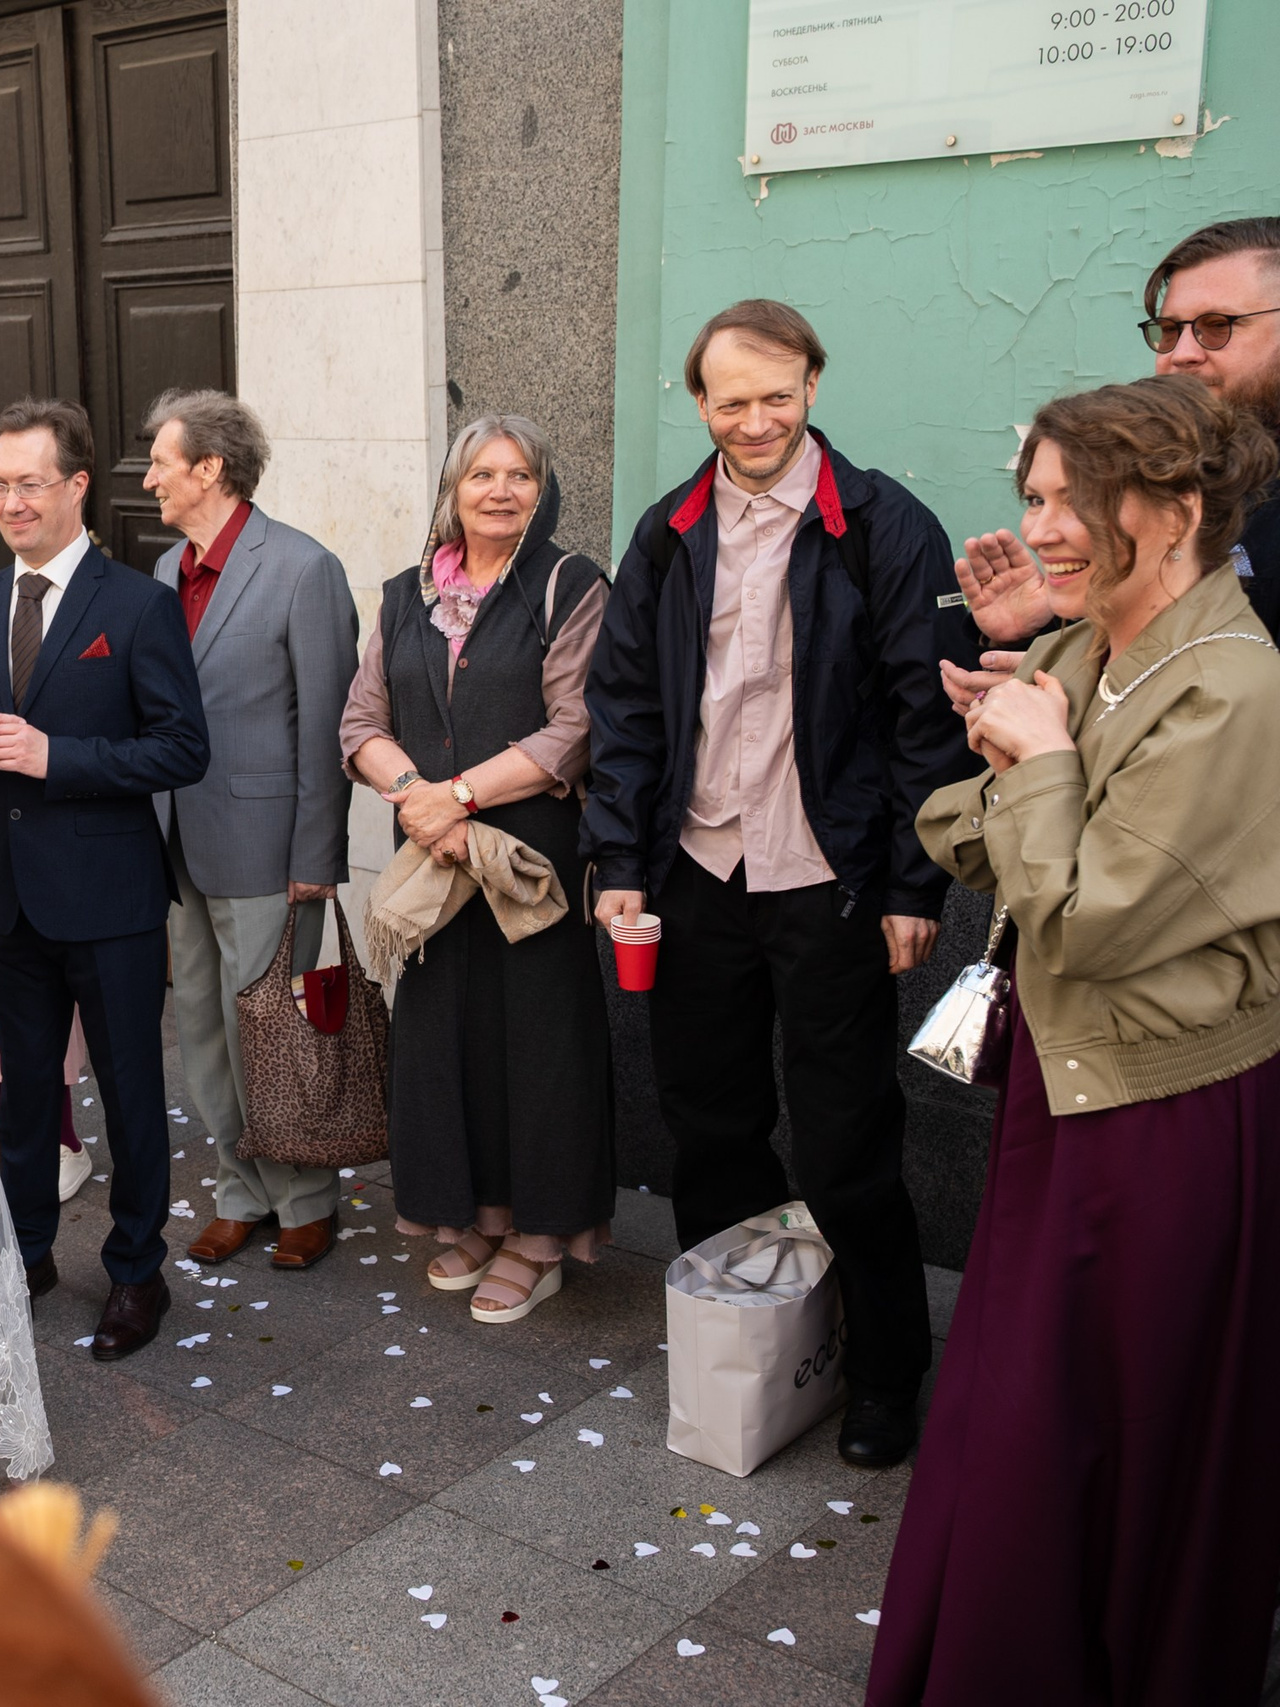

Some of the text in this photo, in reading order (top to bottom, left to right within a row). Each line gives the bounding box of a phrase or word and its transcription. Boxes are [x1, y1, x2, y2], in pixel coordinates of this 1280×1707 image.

[1050, 7, 1096, 31] 9:00
[1114, 0, 1175, 23] 20:00
[772, 21, 836, 38] ПОНЕДЕЛЬНИК
[842, 14, 883, 28] ПЯТНИЦА
[1038, 41, 1094, 65] 10:00
[1115, 31, 1173, 55] 19:00
[772, 55, 809, 68] СУББОТА
[771, 82, 829, 98] ВОСКРЕСЕНЬЕ
[803, 119, 874, 136] ЗАГС МОСКВЫ
